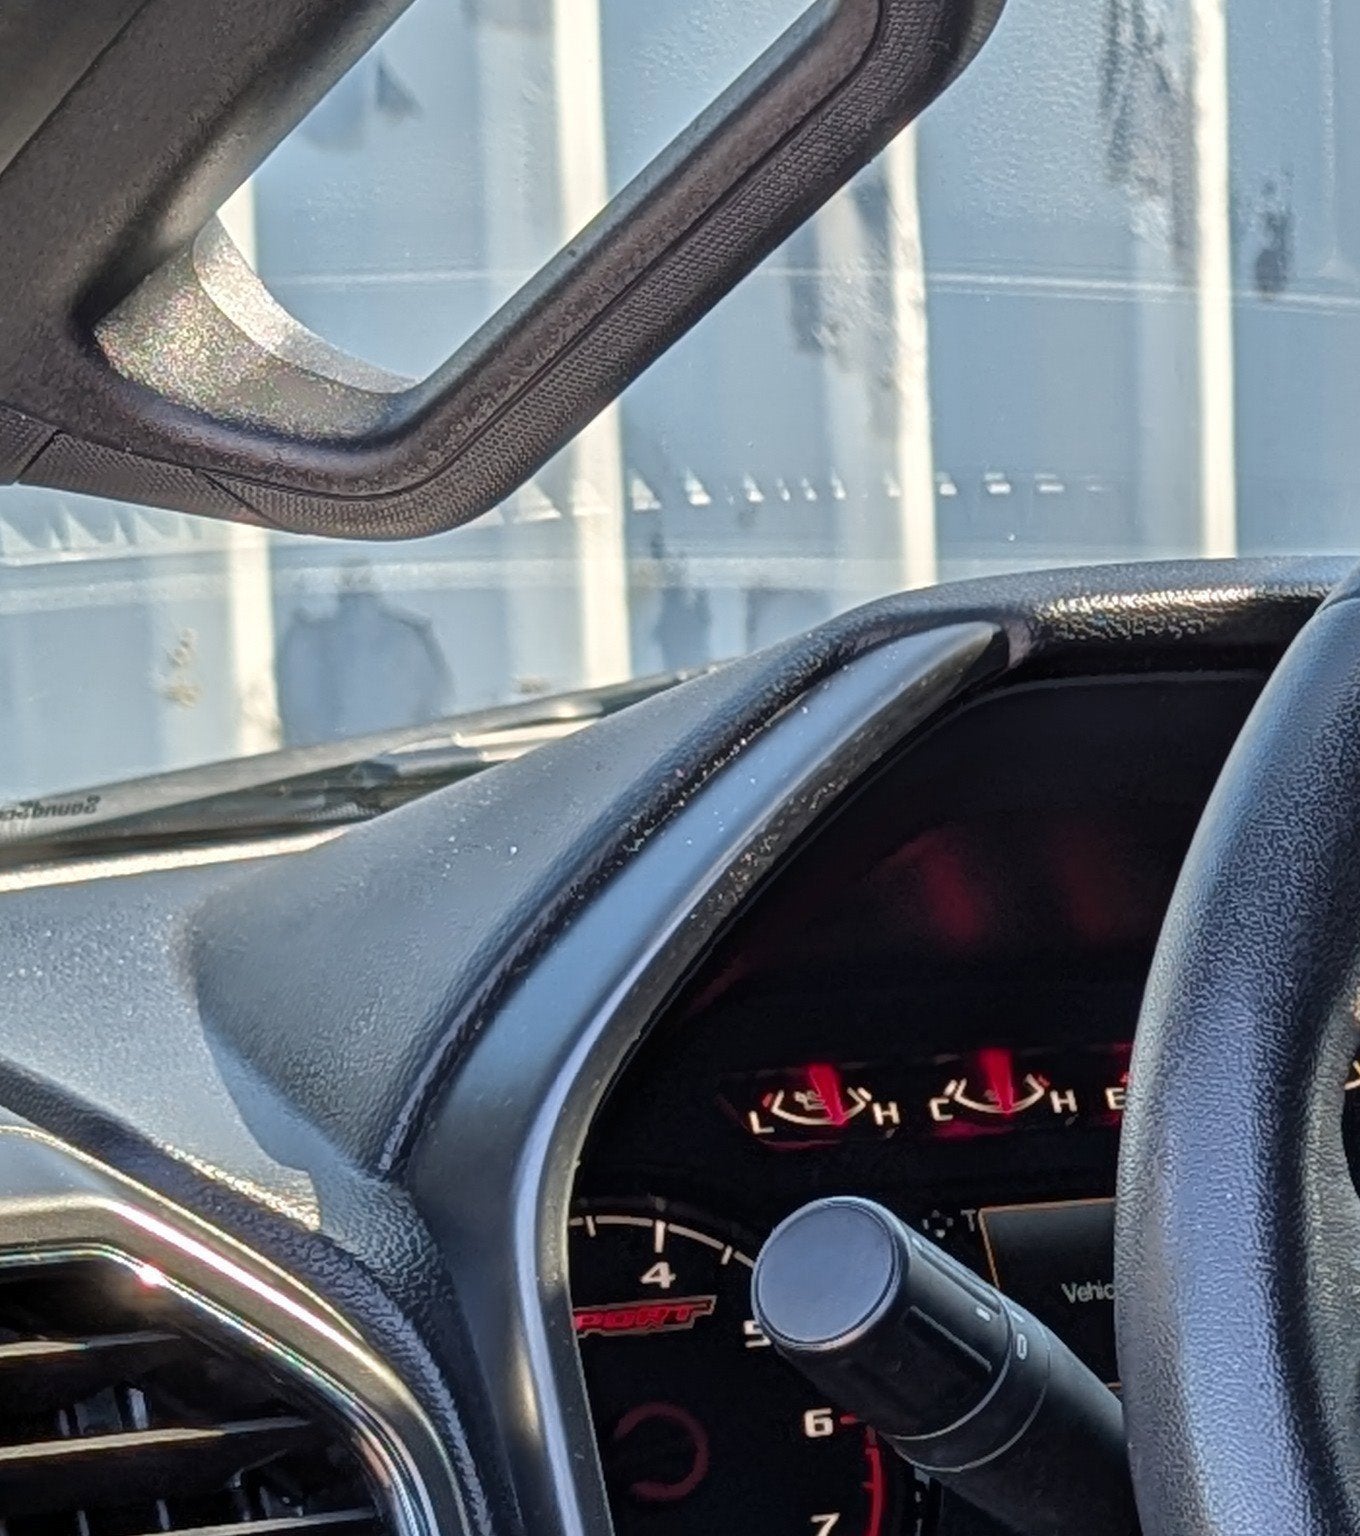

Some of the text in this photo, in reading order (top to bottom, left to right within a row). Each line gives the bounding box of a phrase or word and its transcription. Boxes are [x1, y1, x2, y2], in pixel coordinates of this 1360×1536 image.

[873, 1102, 900, 1126] H
[929, 1097, 954, 1122] C
[1050, 1089, 1078, 1114] H
[750, 1110, 775, 1134] L
[639, 1261, 677, 1289] 4
[573, 1301, 713, 1331] PORT
[804, 1408, 833, 1439] 6
